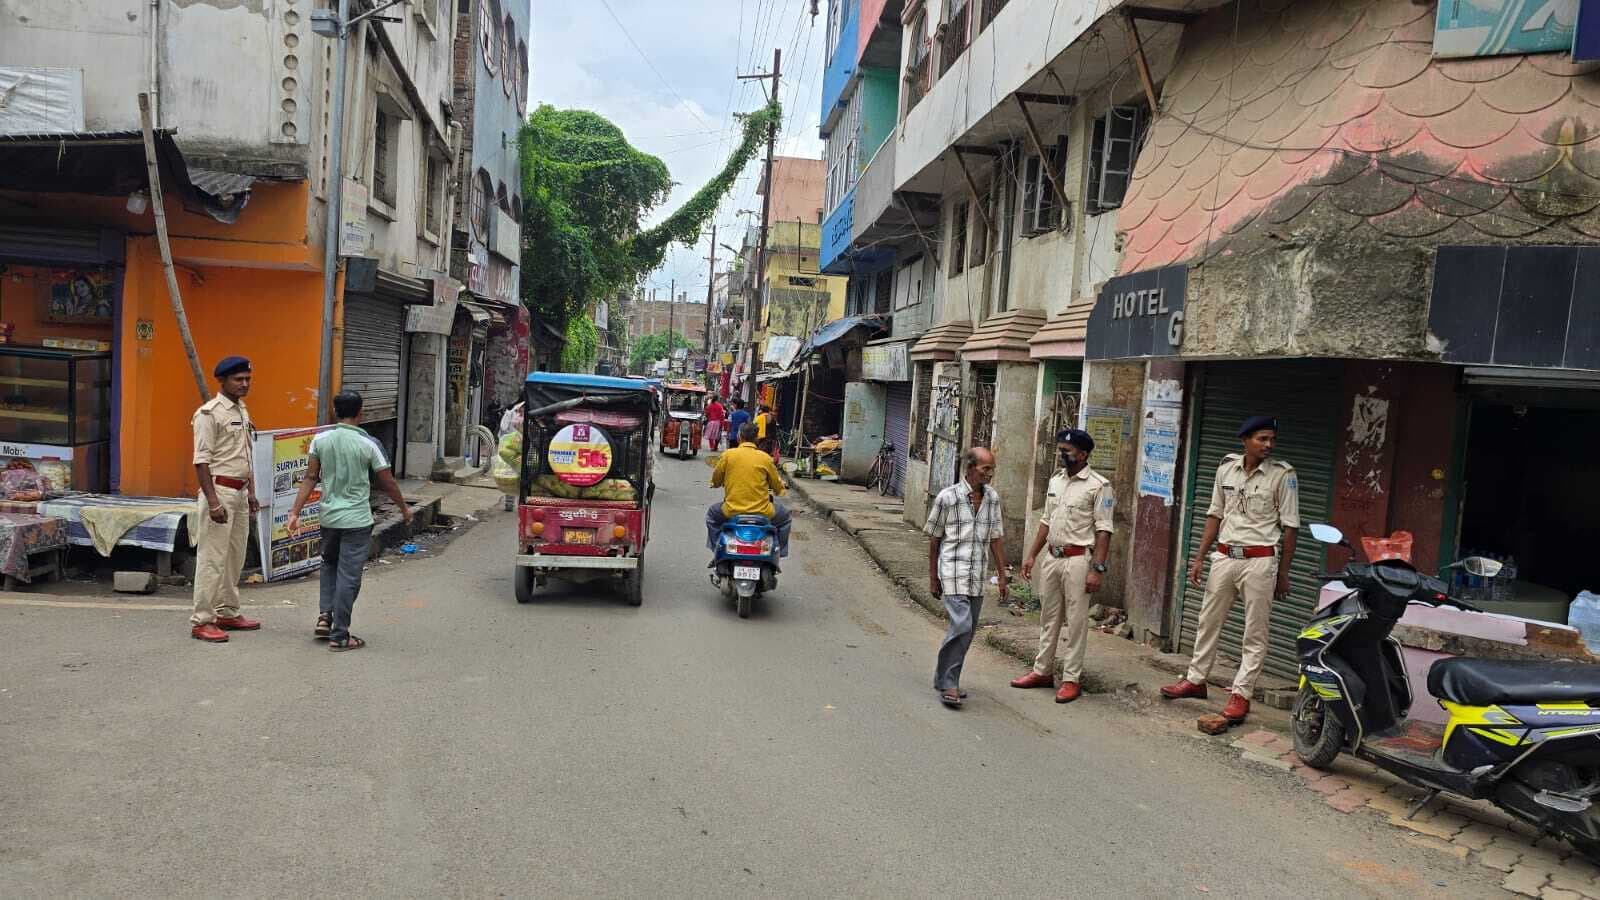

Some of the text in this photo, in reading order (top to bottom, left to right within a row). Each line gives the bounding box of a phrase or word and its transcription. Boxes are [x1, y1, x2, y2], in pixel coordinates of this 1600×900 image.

[1113, 288, 1168, 318] HOTEL
[1167, 310, 1185, 347] G
[276, 458, 308, 472] SURYA PL
